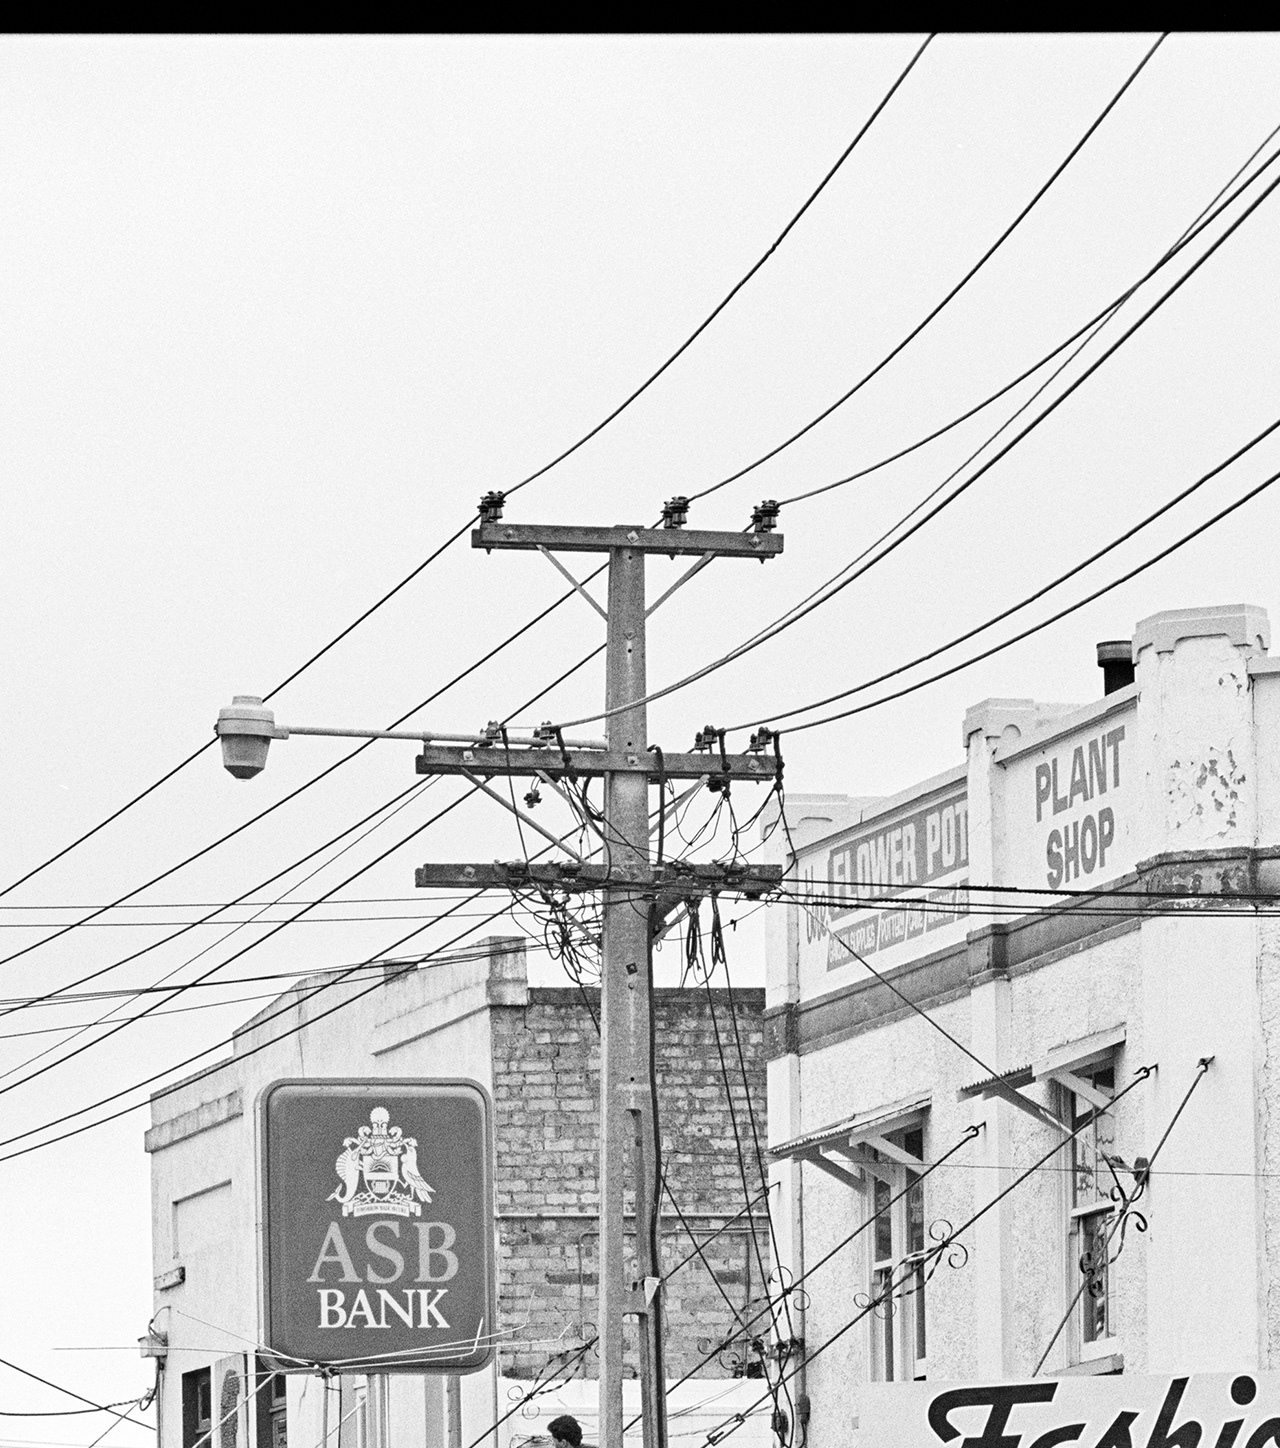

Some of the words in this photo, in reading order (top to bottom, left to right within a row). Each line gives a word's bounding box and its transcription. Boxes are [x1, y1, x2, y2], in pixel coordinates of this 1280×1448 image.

[1035, 724, 1125, 823] PLANT
[832, 822, 917, 914] FLOWER
[1046, 806, 1115, 890] SHOP
[306, 1220, 460, 1285] ASB
[317, 1289, 451, 1329] BANK
